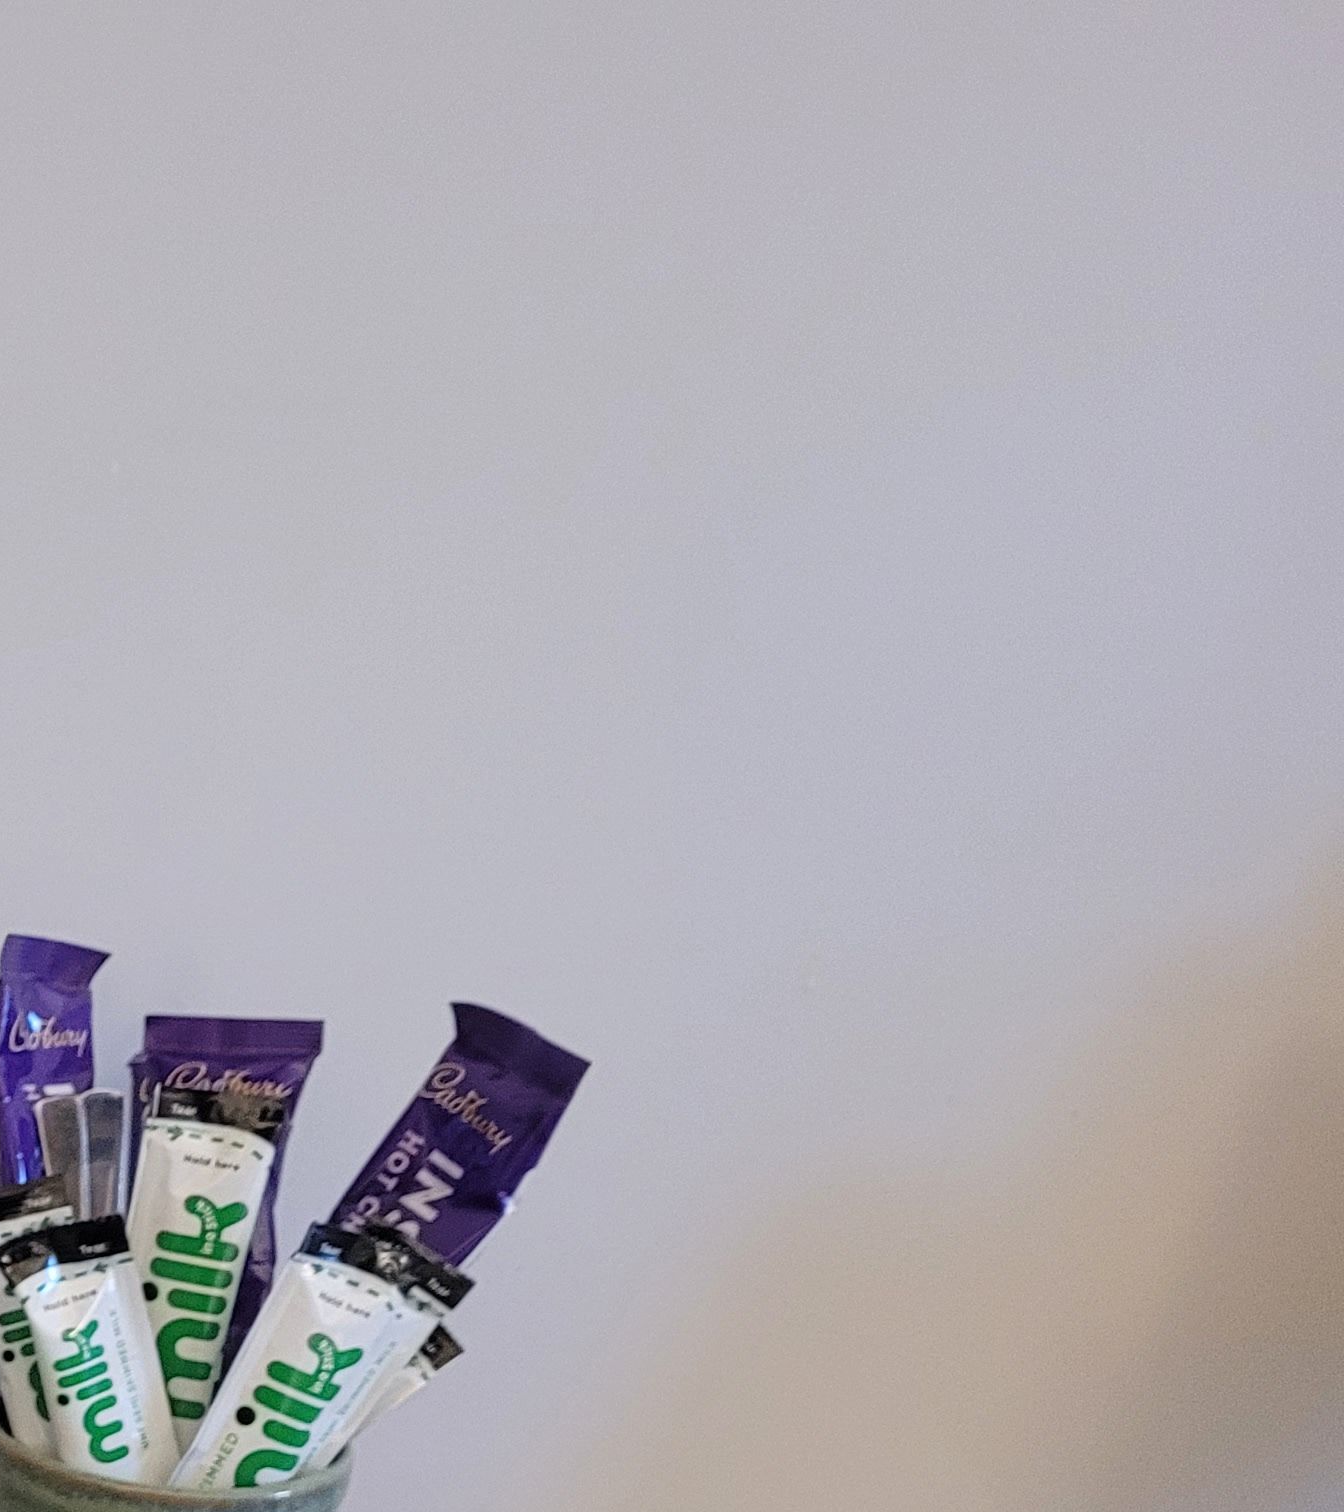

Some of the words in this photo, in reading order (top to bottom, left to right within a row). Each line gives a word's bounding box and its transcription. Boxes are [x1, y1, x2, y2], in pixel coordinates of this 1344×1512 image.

[418, 1062, 512, 1155] Cadbury
[377, 1128, 426, 1192] HOT
[54, 1319, 129, 1464] milk
